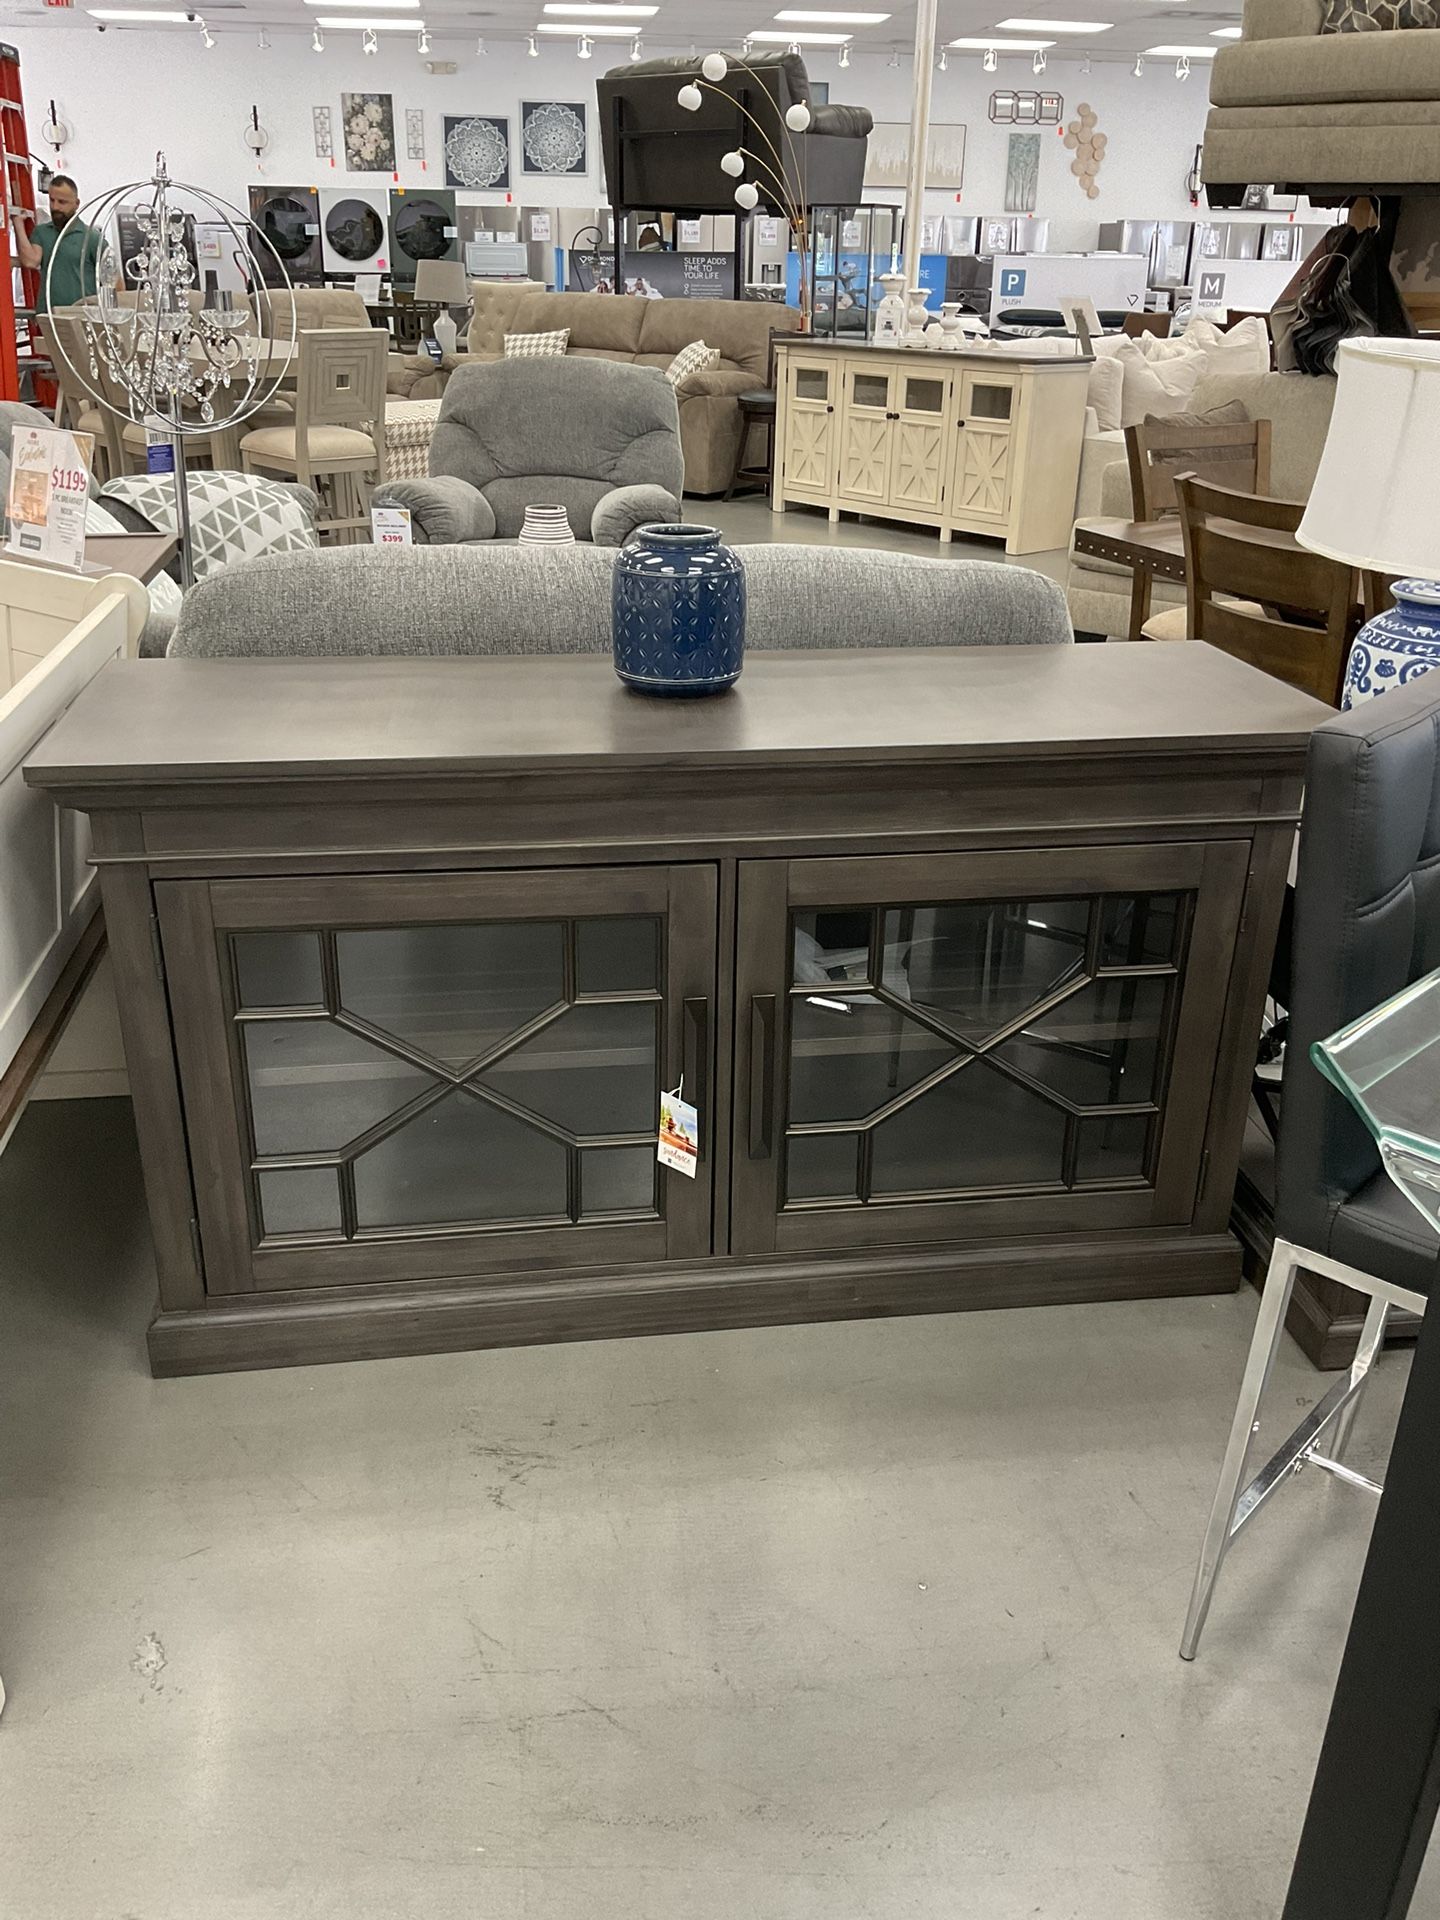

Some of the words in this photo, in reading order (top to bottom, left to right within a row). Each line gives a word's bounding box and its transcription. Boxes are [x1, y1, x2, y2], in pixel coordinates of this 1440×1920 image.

[684, 257, 706, 265] SLEEP
[707, 257, 727, 265] ADDS
[1007, 274, 1020, 291] P
[1204, 277, 1220, 295] M
[51, 465, 87, 492] $1199
[382, 534, 403, 542] $399
